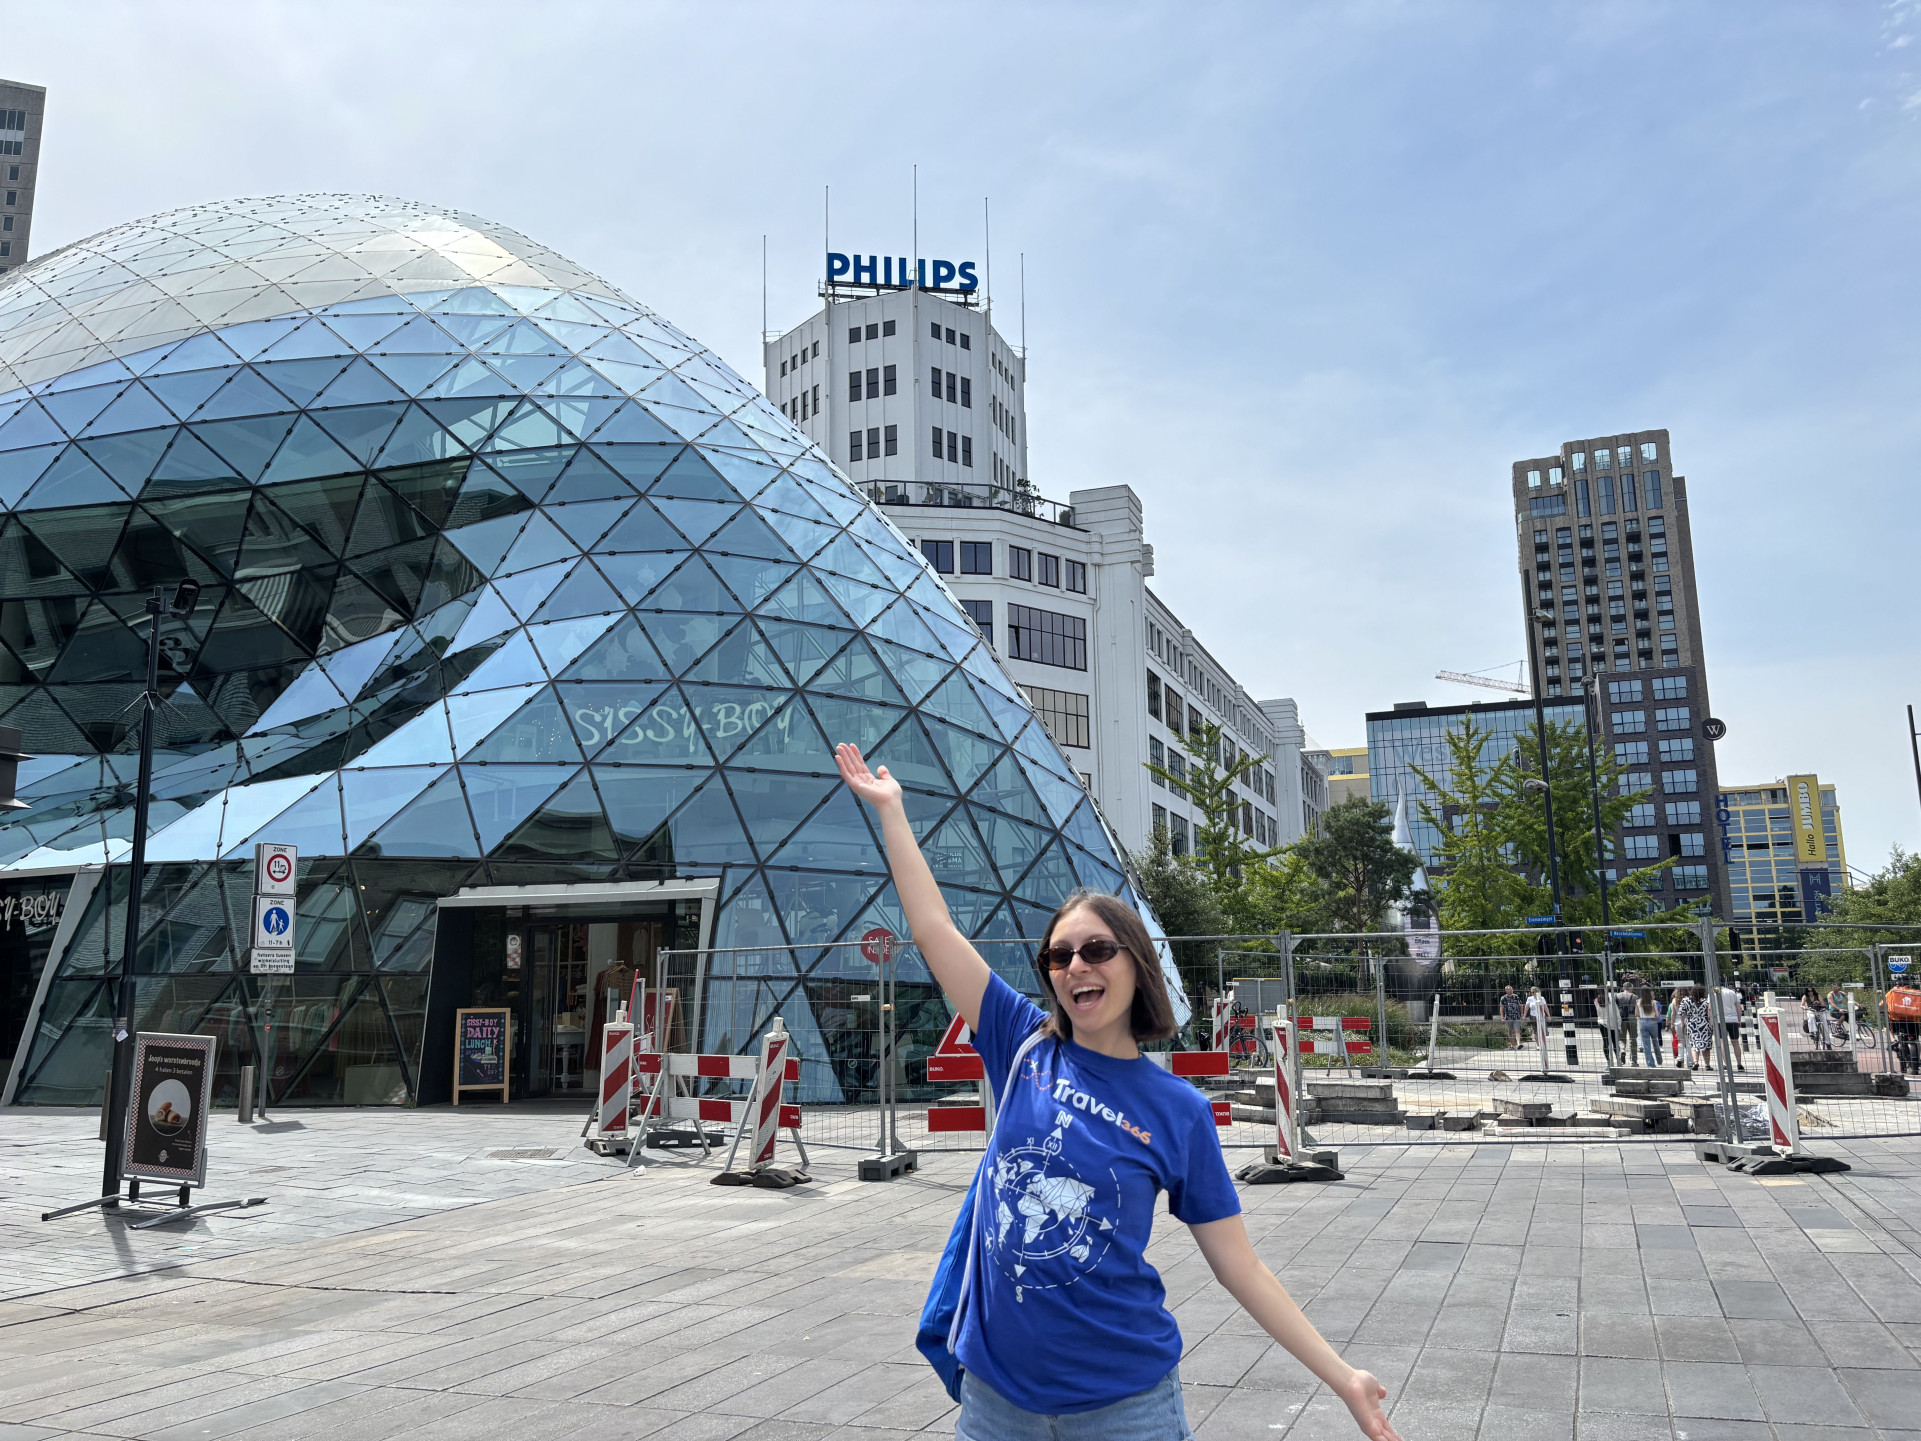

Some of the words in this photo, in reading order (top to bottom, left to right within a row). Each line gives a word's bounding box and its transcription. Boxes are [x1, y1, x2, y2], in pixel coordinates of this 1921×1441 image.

[827, 253, 979, 291] PHILIPS
[1706, 724, 1721, 736] W
[1797, 781, 1815, 830] JUMBO
[1714, 794, 1735, 865] HOTEL
[1806, 833, 1816, 857] Hallo
[467, 1027, 500, 1038] DAILY
[1055, 1110, 1073, 1129] N
